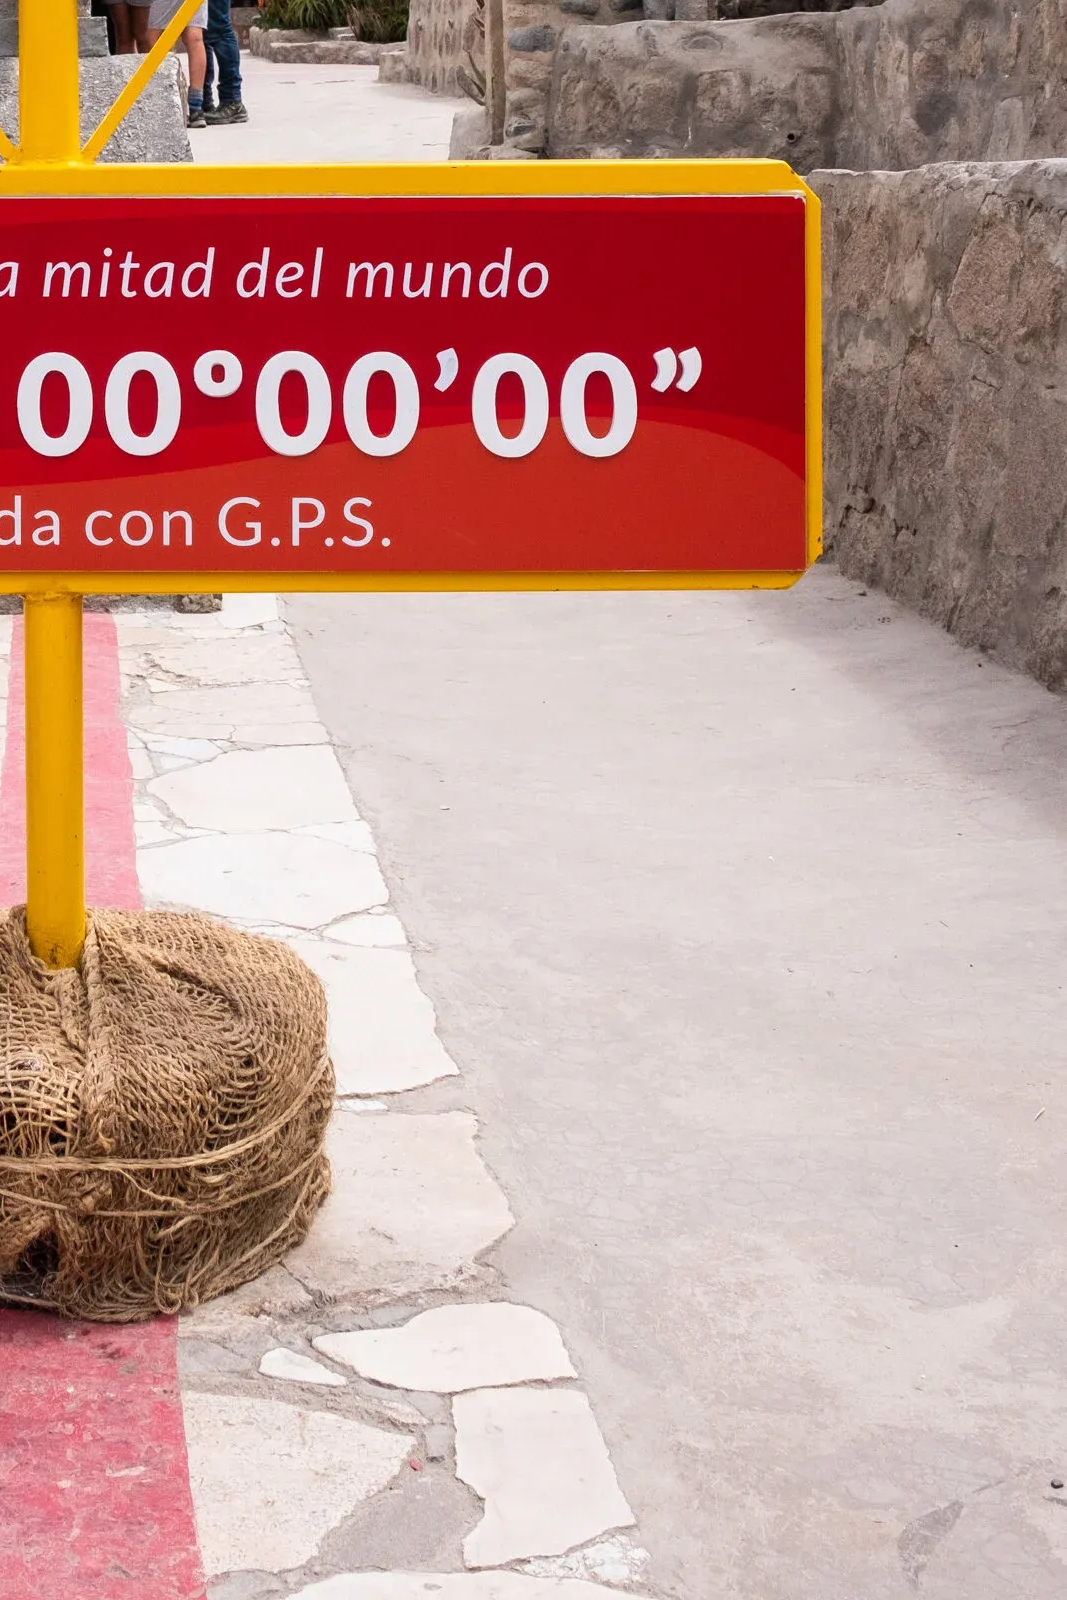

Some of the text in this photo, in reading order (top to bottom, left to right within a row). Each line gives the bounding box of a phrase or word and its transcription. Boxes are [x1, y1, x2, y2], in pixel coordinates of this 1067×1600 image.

[42, 247, 216, 298] mitad
[236, 246, 324, 298] del
[345, 246, 550, 298] mundo
[84, 509, 193, 547] con
[217, 496, 391, 548] G.P.S.
